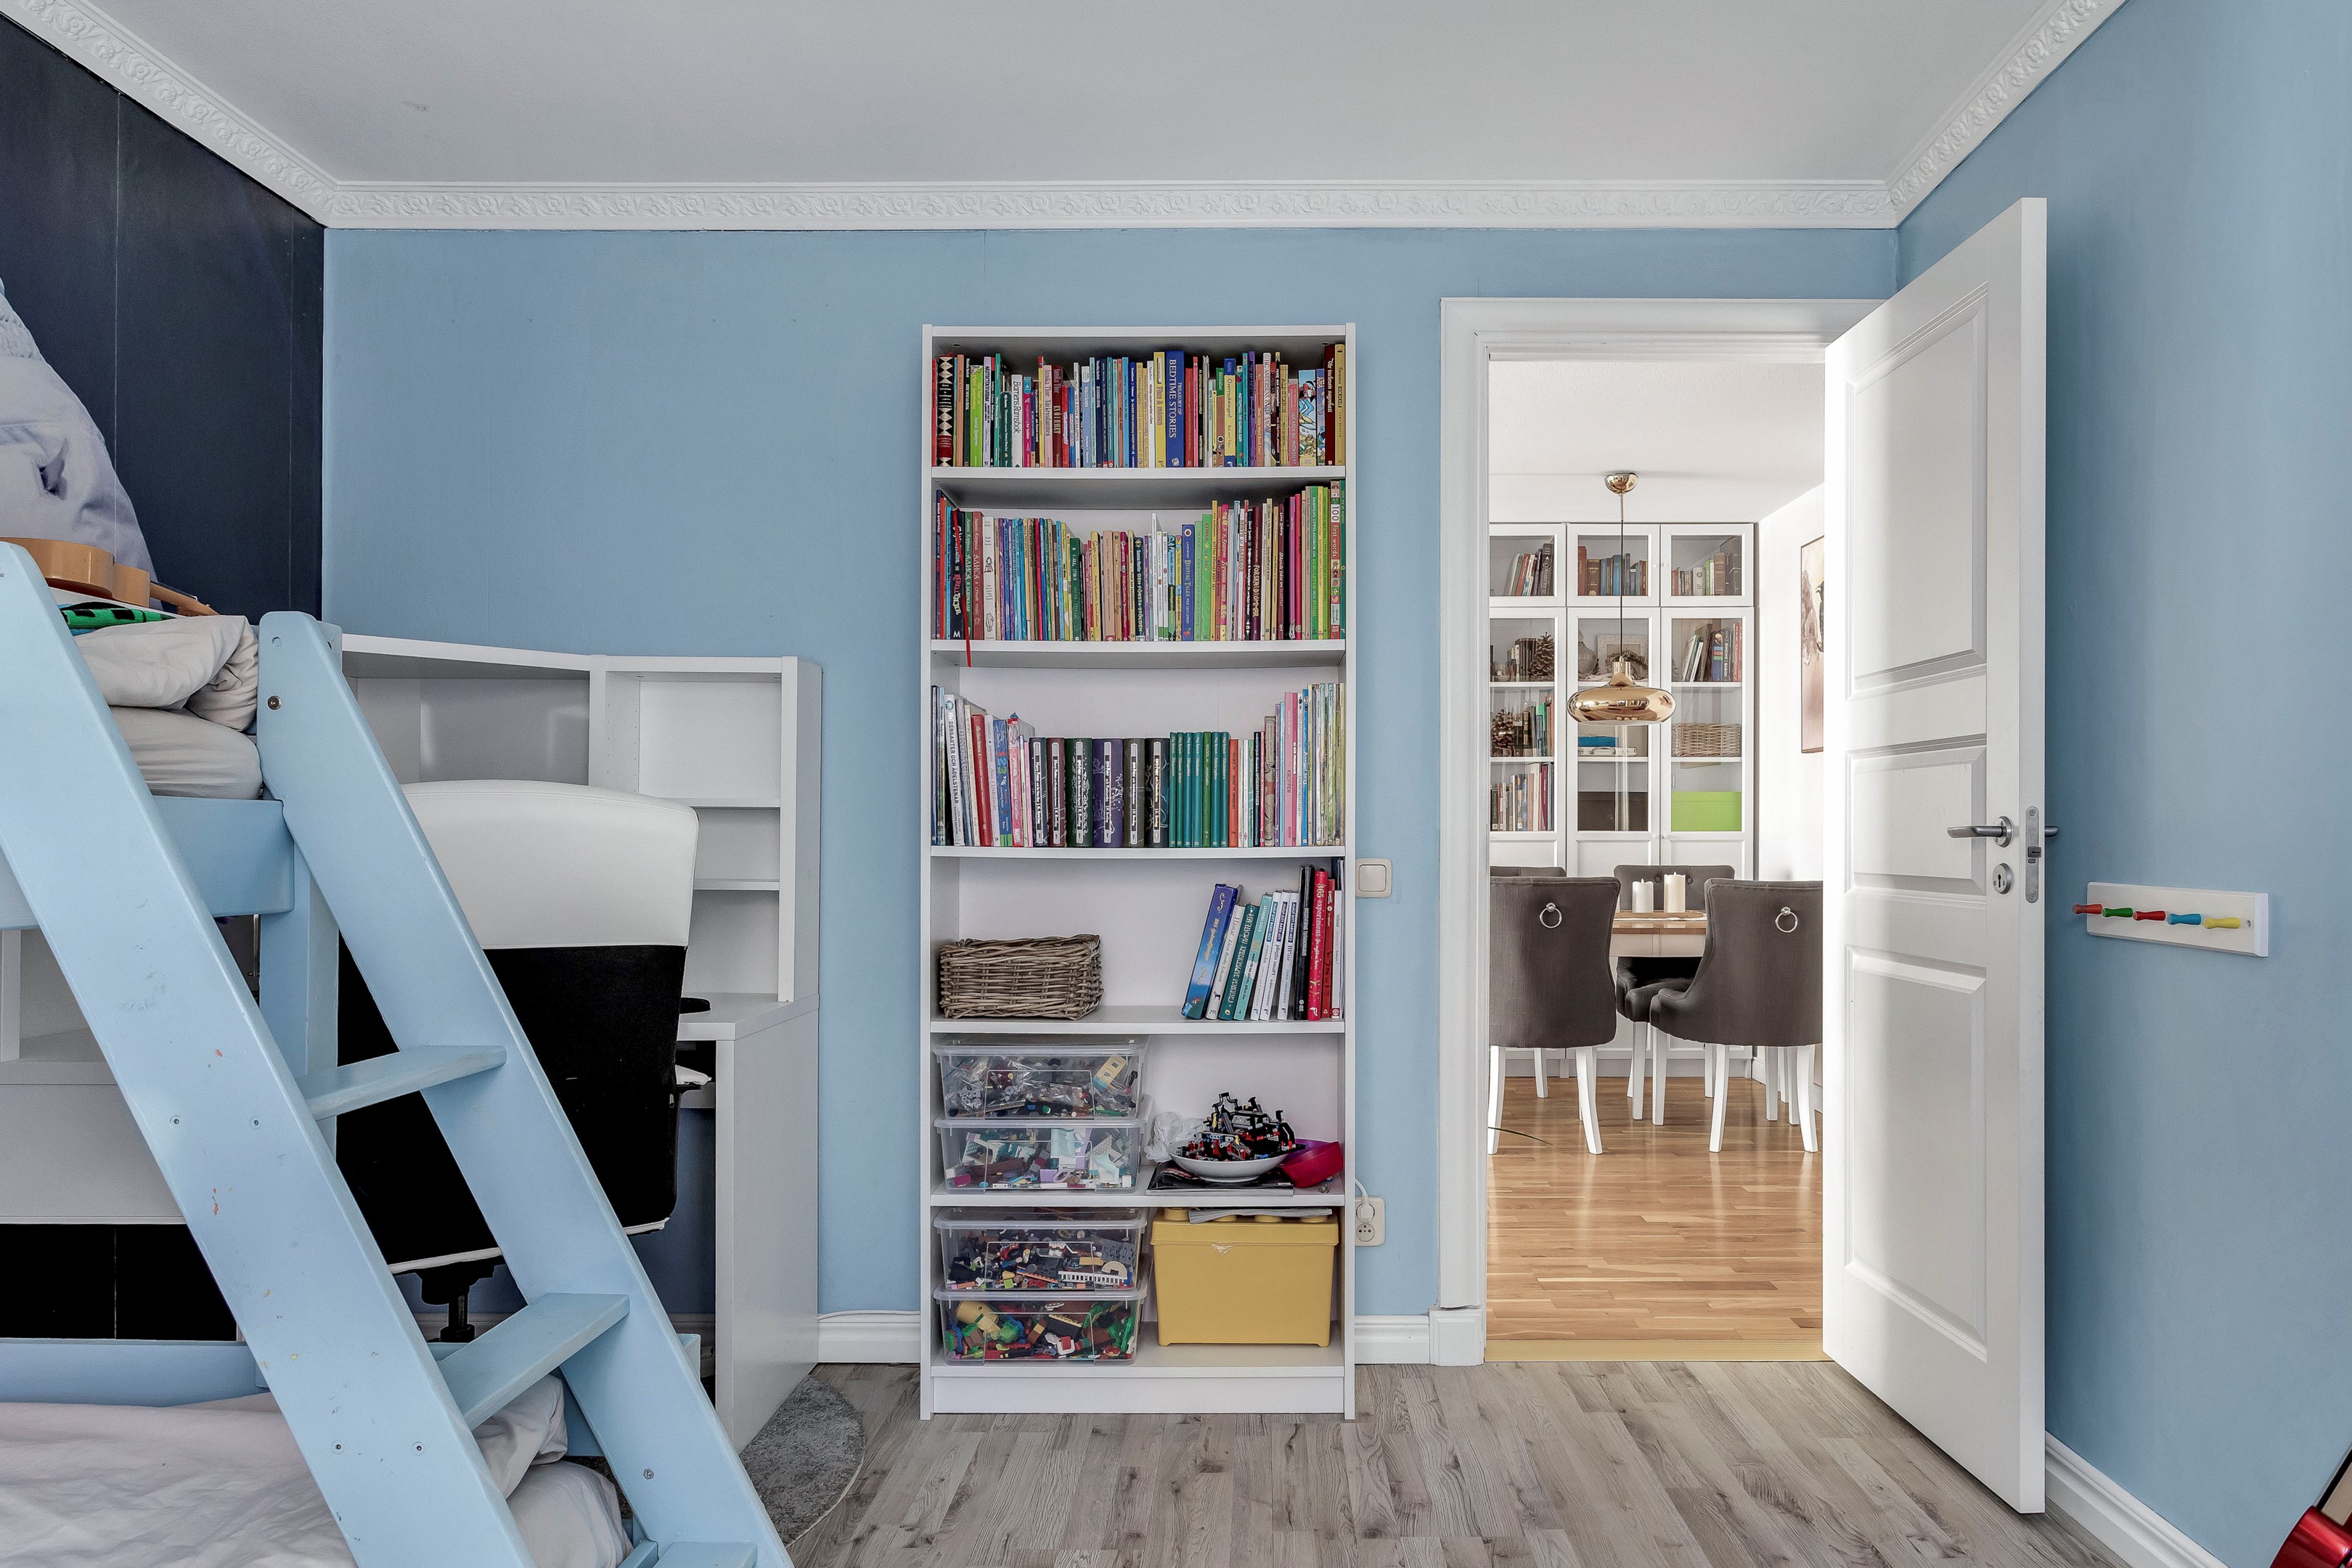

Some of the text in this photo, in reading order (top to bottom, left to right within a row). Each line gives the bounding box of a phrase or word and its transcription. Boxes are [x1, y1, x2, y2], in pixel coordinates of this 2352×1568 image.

[951, 767, 960, 804] ÄDELSTENAR
[1229, 917, 1240, 936] Hästar
[1315, 899, 1323, 937] experiment
